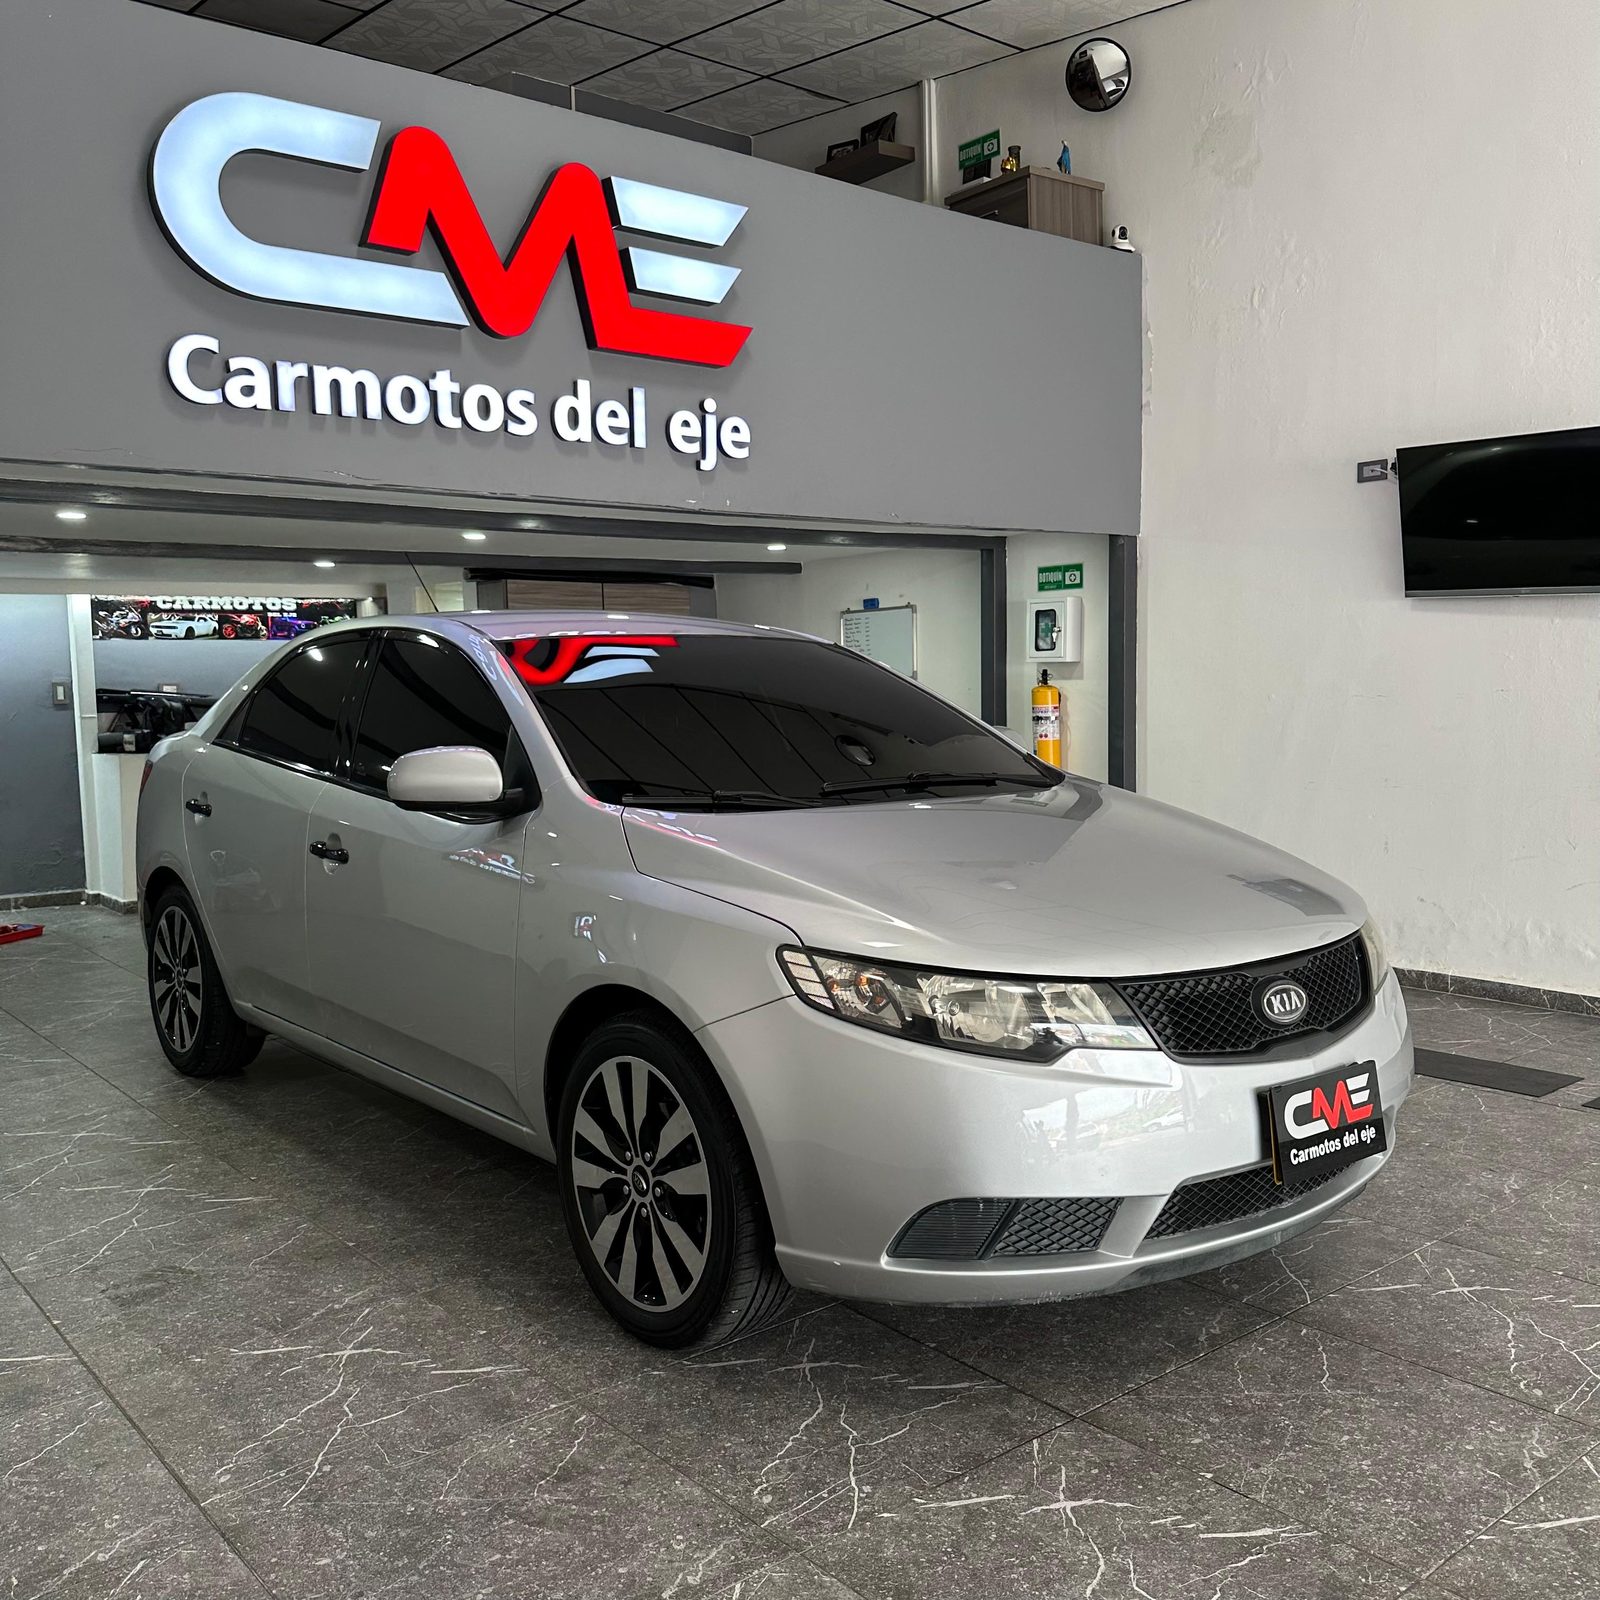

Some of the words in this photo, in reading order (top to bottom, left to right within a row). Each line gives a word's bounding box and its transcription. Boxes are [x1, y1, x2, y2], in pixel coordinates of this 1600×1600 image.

[148, 91, 754, 367] CME
[167, 333, 538, 437] Carmotos
[553, 379, 647, 450] del
[666, 397, 752, 471] eje
[156, 595, 297, 611] CARMOTOS
[1270, 991, 1301, 1014] KIA
[1284, 1073, 1373, 1139] CME
[1290, 1138, 1341, 1165] Carmotos
[1343, 1131, 1359, 1147] del
[1361, 1125, 1376, 1144] eje
